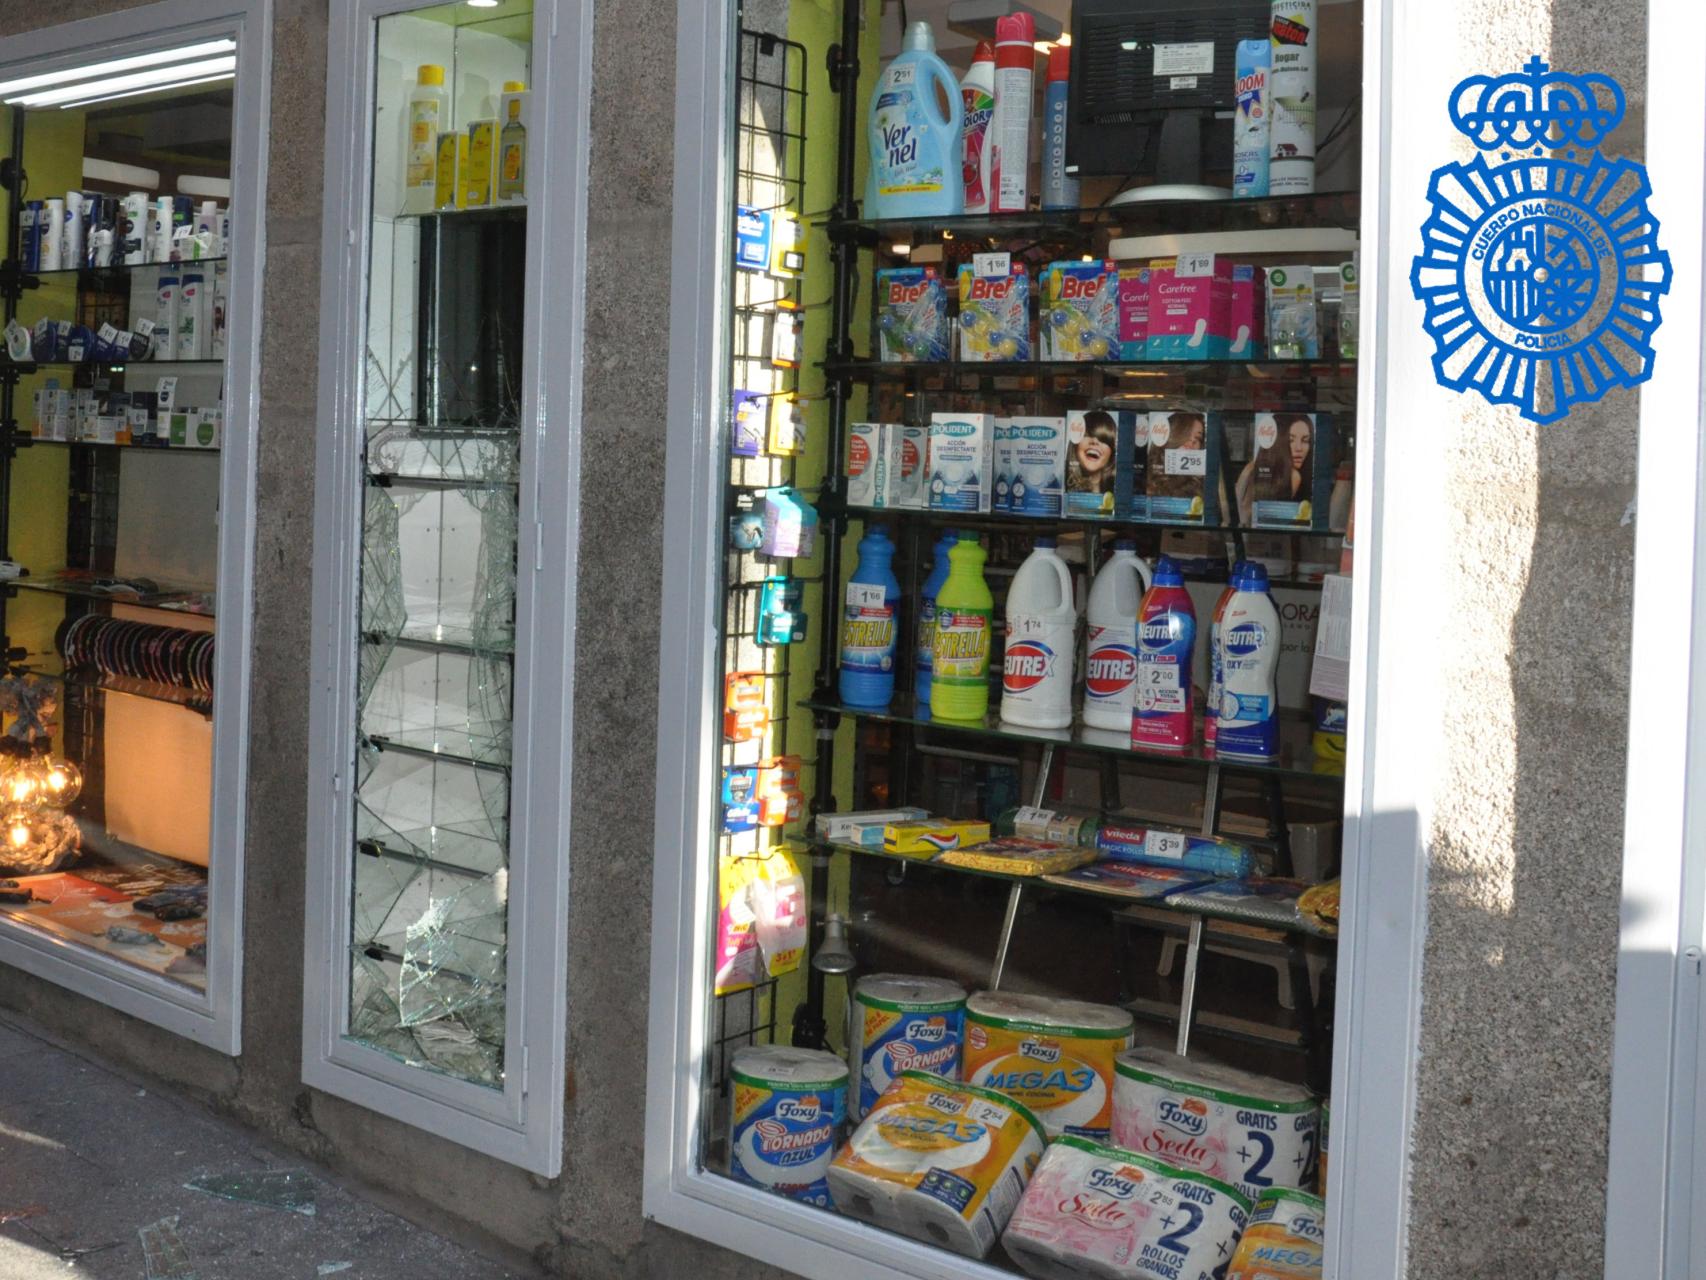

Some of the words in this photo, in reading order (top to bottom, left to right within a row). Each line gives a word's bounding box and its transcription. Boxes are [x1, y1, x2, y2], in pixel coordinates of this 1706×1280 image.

[882, 124, 911, 150] Ver
[889, 138, 917, 168] nel
[888, 281, 928, 305] Bref
[970, 276, 1015, 301] Bref
[1061, 274, 1107, 299] Bref
[1158, 283, 1198, 294] Carefree
[932, 424, 973, 435] POLIDENT
[1011, 428, 1054, 438] POLIDENT
[1225, 630, 1269, 647] NEUTREX
[1142, 653, 1157, 662] OXY
[1227, 659, 1243, 669] OXY
[910, 1024, 944, 1040] Foxy
[892, 1044, 956, 1073] TORNADO
[1021, 1042, 1058, 1061] Foxy
[983, 1067, 1096, 1093] MEGA3
[779, 1102, 817, 1120] Foxy
[928, 1092, 961, 1114] Foxy
[1159, 1100, 1203, 1132] Foxy
[1236, 1110, 1278, 1131] GRATIS
[761, 1124, 832, 1152] TORNADO
[1143, 1128, 1208, 1161] Seda
[1089, 1168, 1137, 1196] Foxy
[1172, 1181, 1216, 1206] GRATIS
[1233, 1182, 1260, 1199] ROLL
[1058, 1193, 1127, 1220] Seda
[1229, 1205, 1249, 1230] GRA
[1136, 1257, 1180, 1280] GRANDES
[1141, 1244, 1186, 1269] ROLLOS
